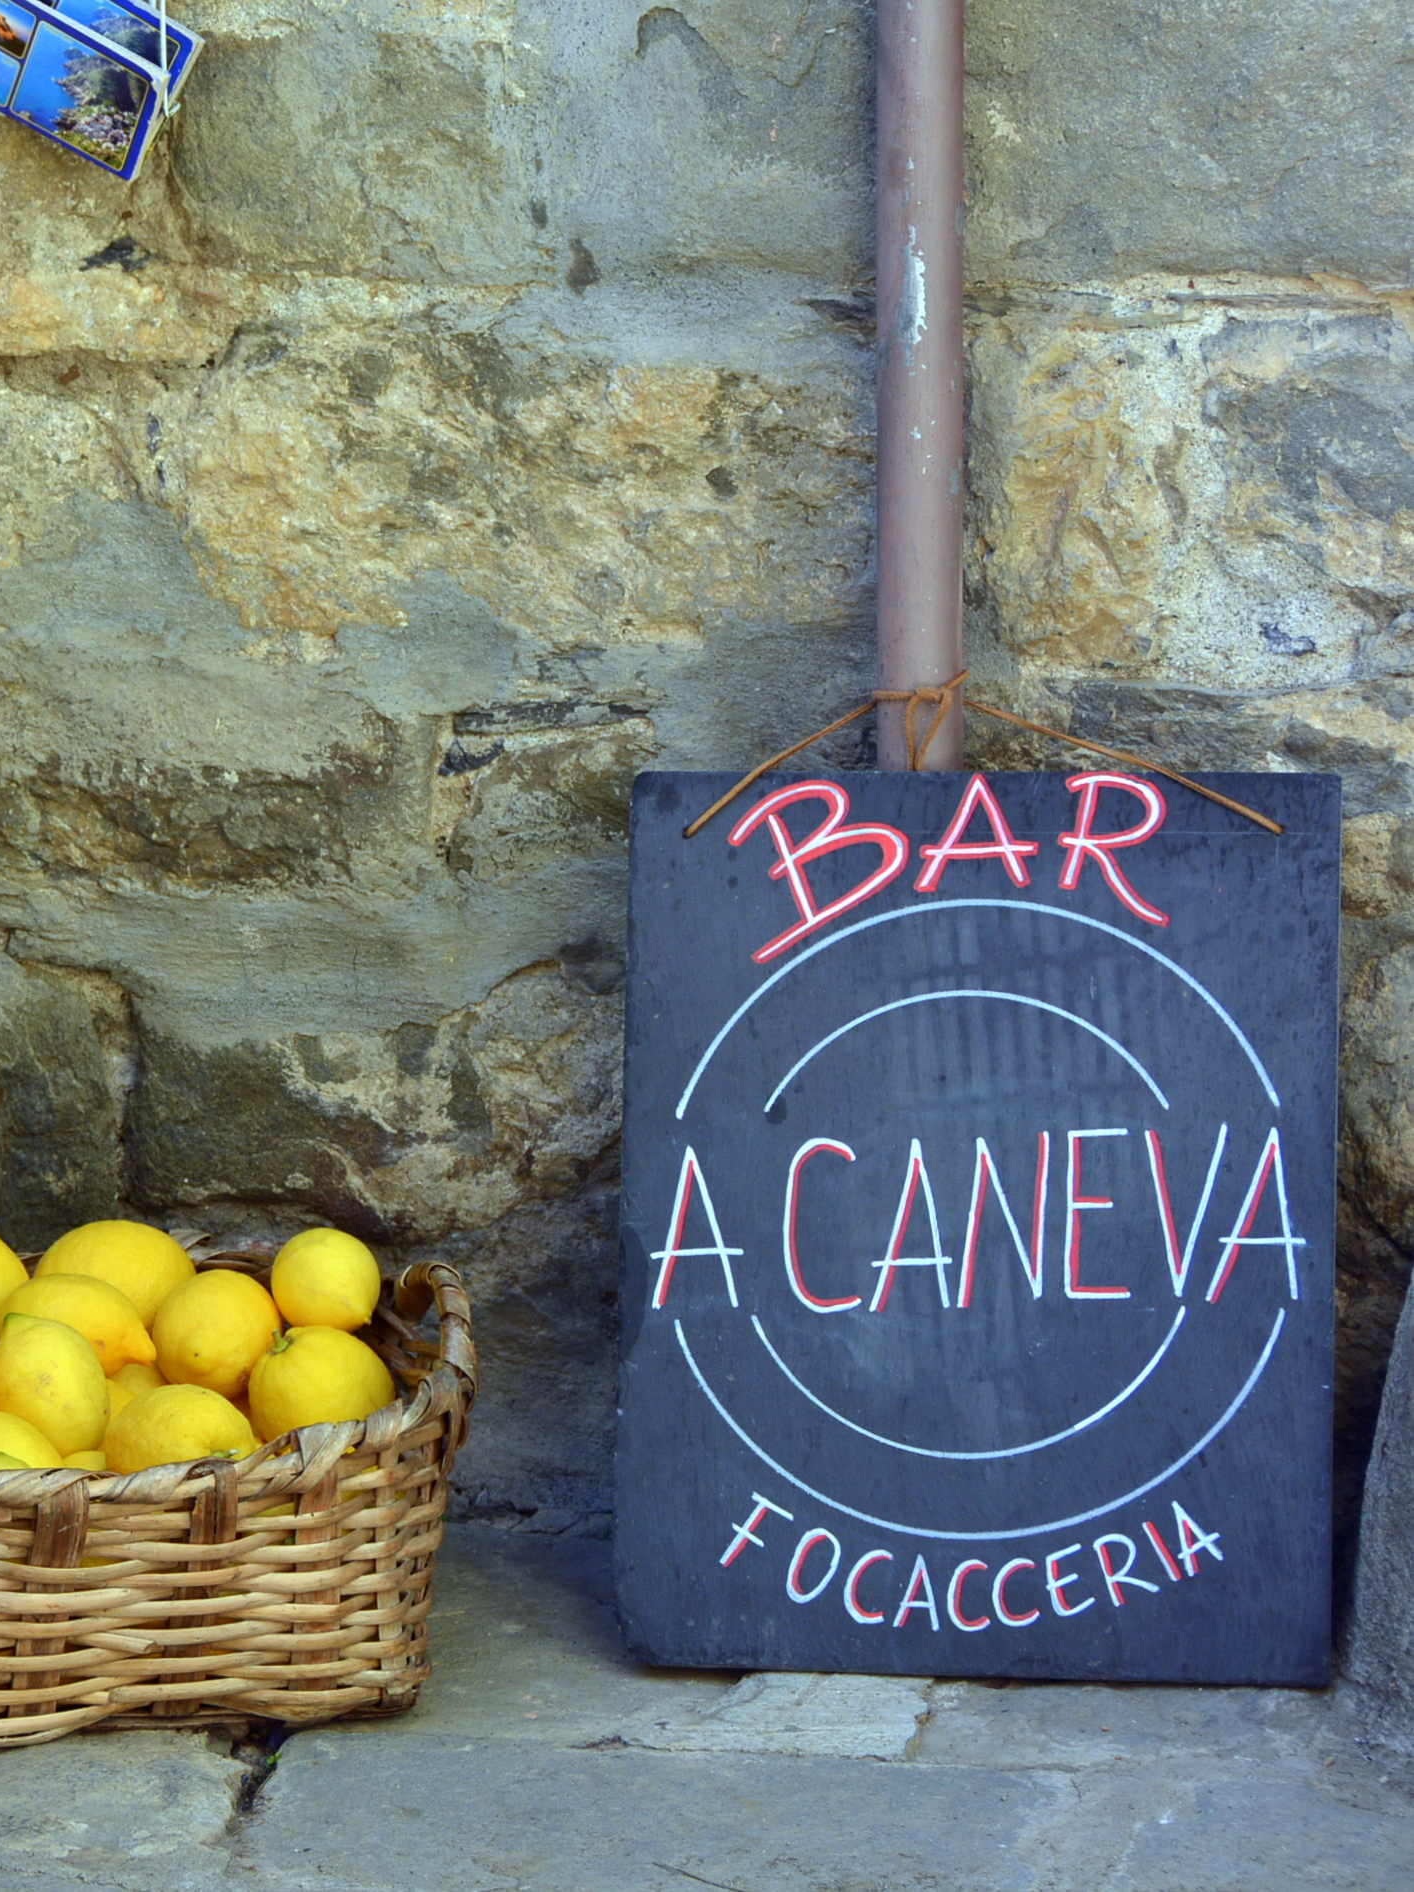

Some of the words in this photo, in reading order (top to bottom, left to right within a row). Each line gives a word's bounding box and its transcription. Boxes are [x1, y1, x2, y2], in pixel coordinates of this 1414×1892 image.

[728, 774, 1169, 963] BAR
[650, 1146, 744, 1309] A
[784, 1123, 1306, 1314] CANEVA
[720, 1492, 1224, 1633] FOCACCERIA
